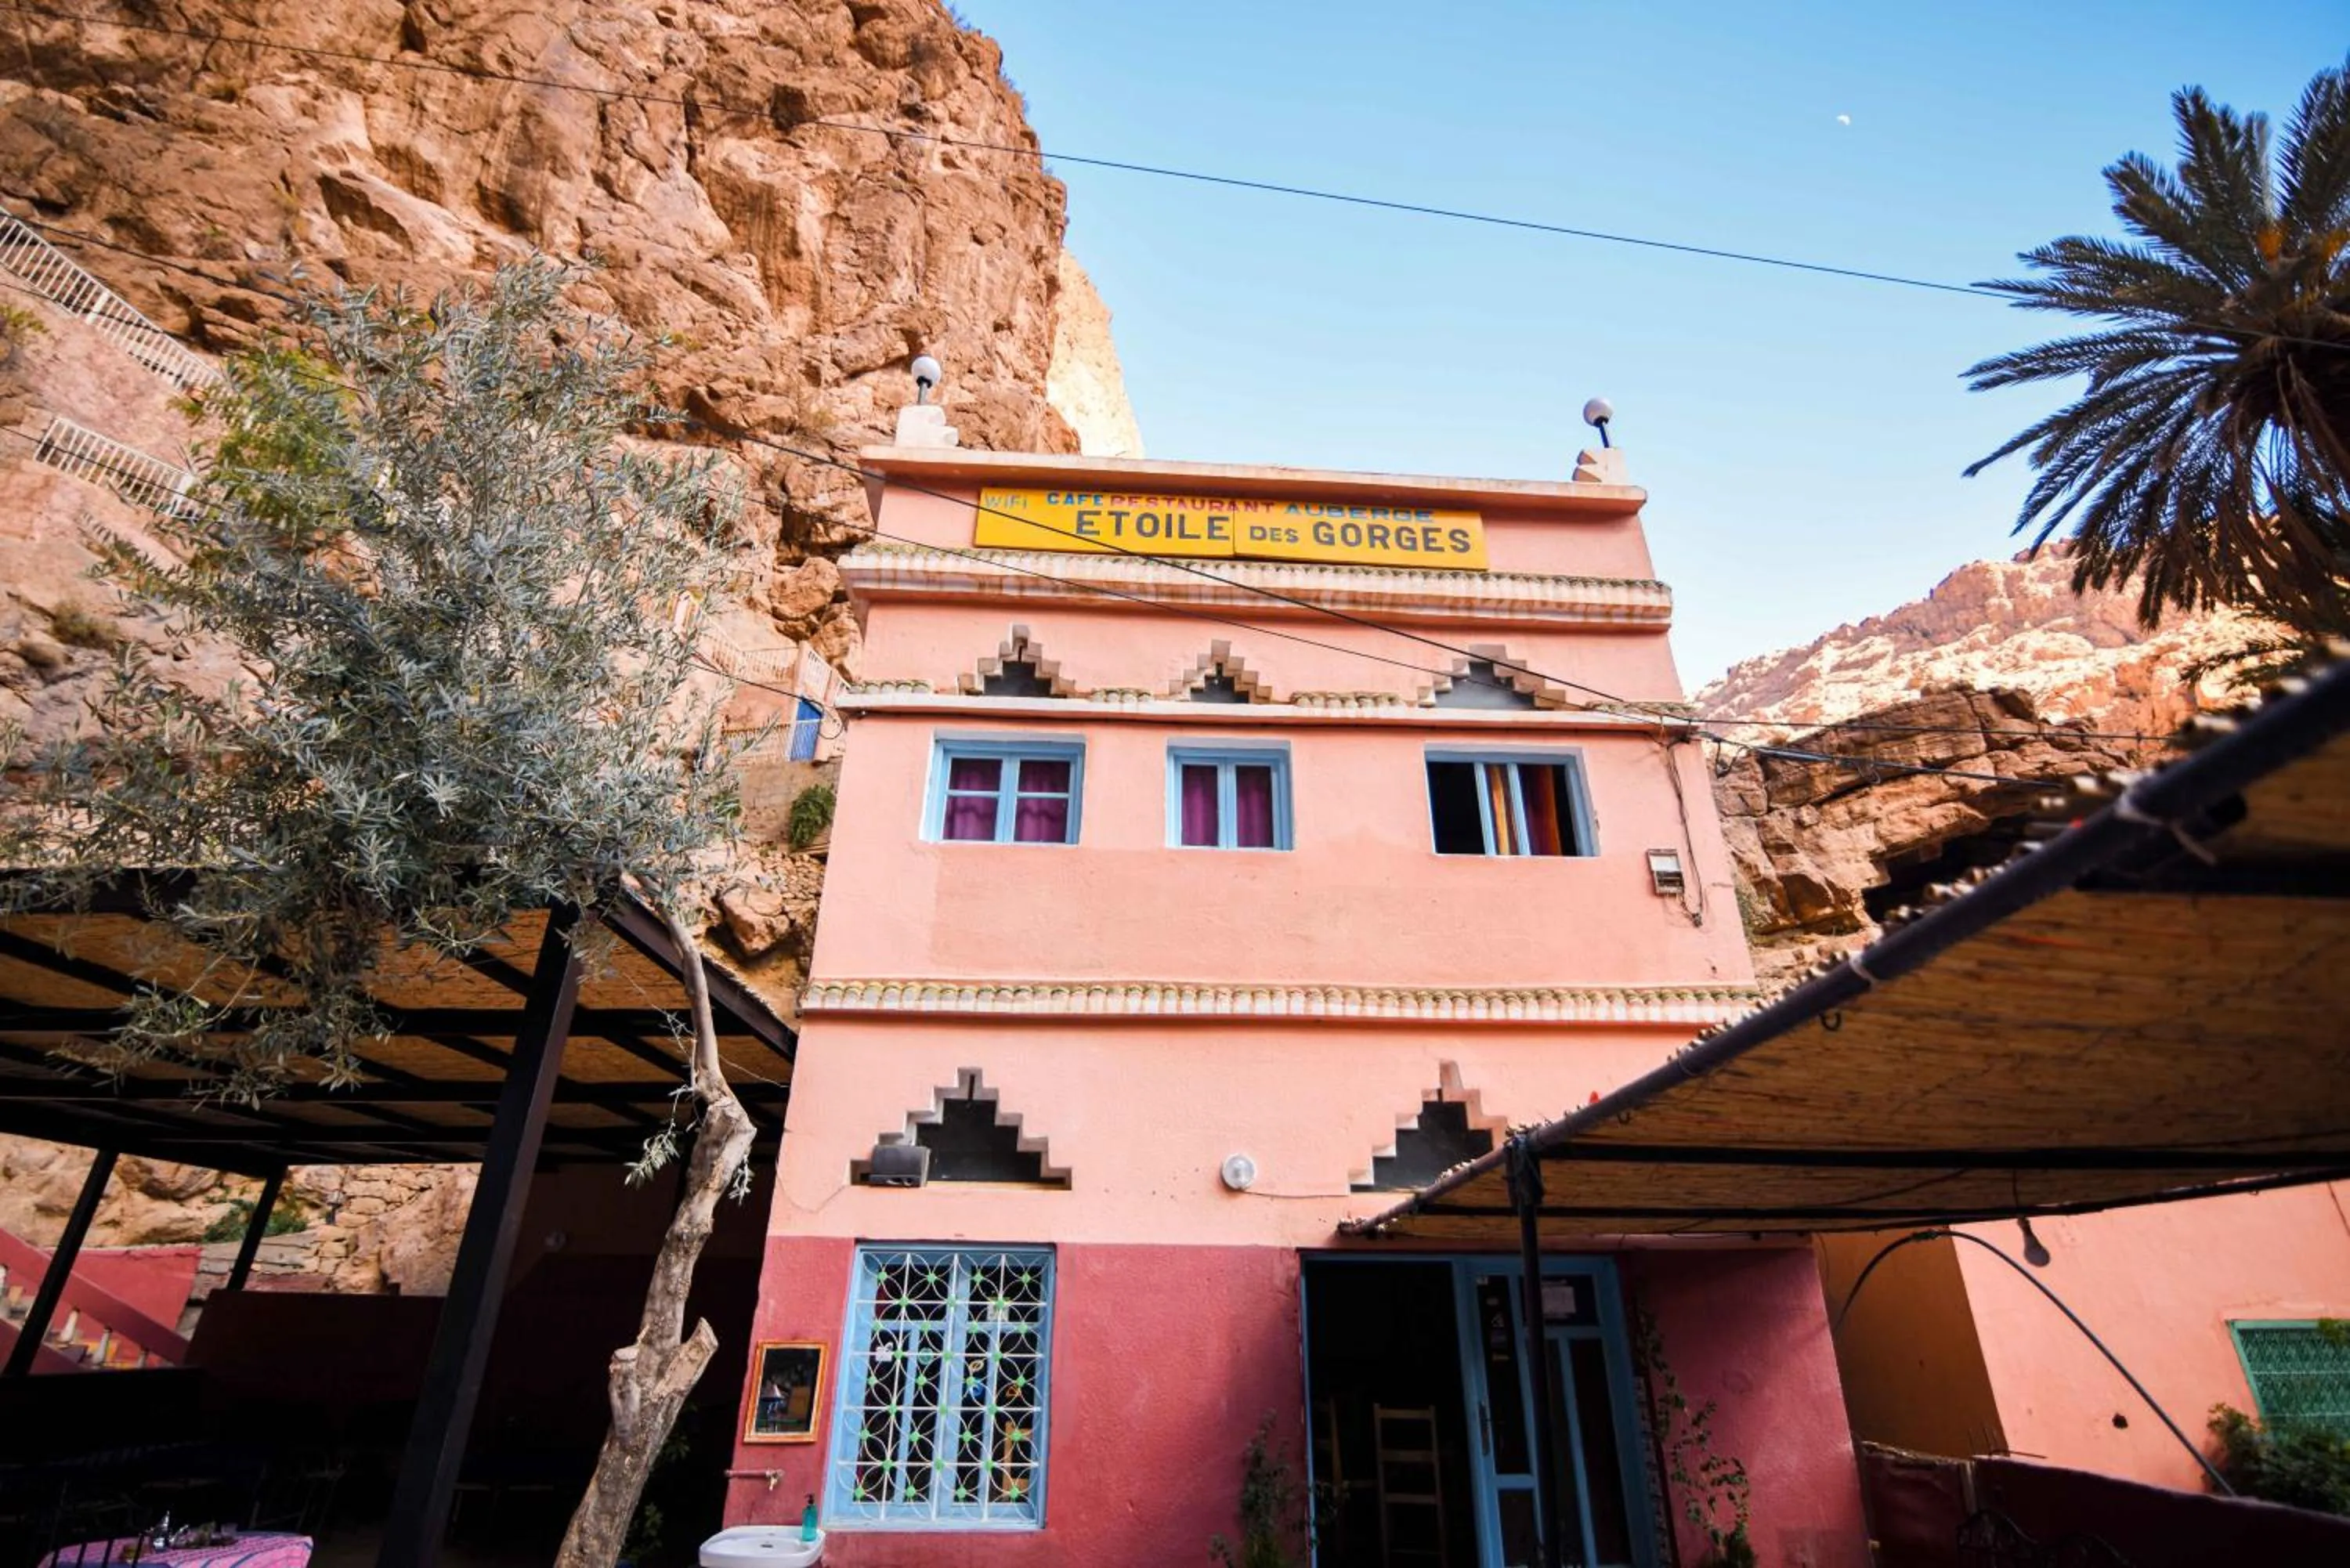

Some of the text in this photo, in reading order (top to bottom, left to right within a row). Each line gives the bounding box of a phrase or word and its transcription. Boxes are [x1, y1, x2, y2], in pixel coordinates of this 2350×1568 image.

[1047, 491, 1434, 522] CAFE RESTAURANT AUBERGE
[1076, 510, 1471, 553] ETOILE DES GORGES
